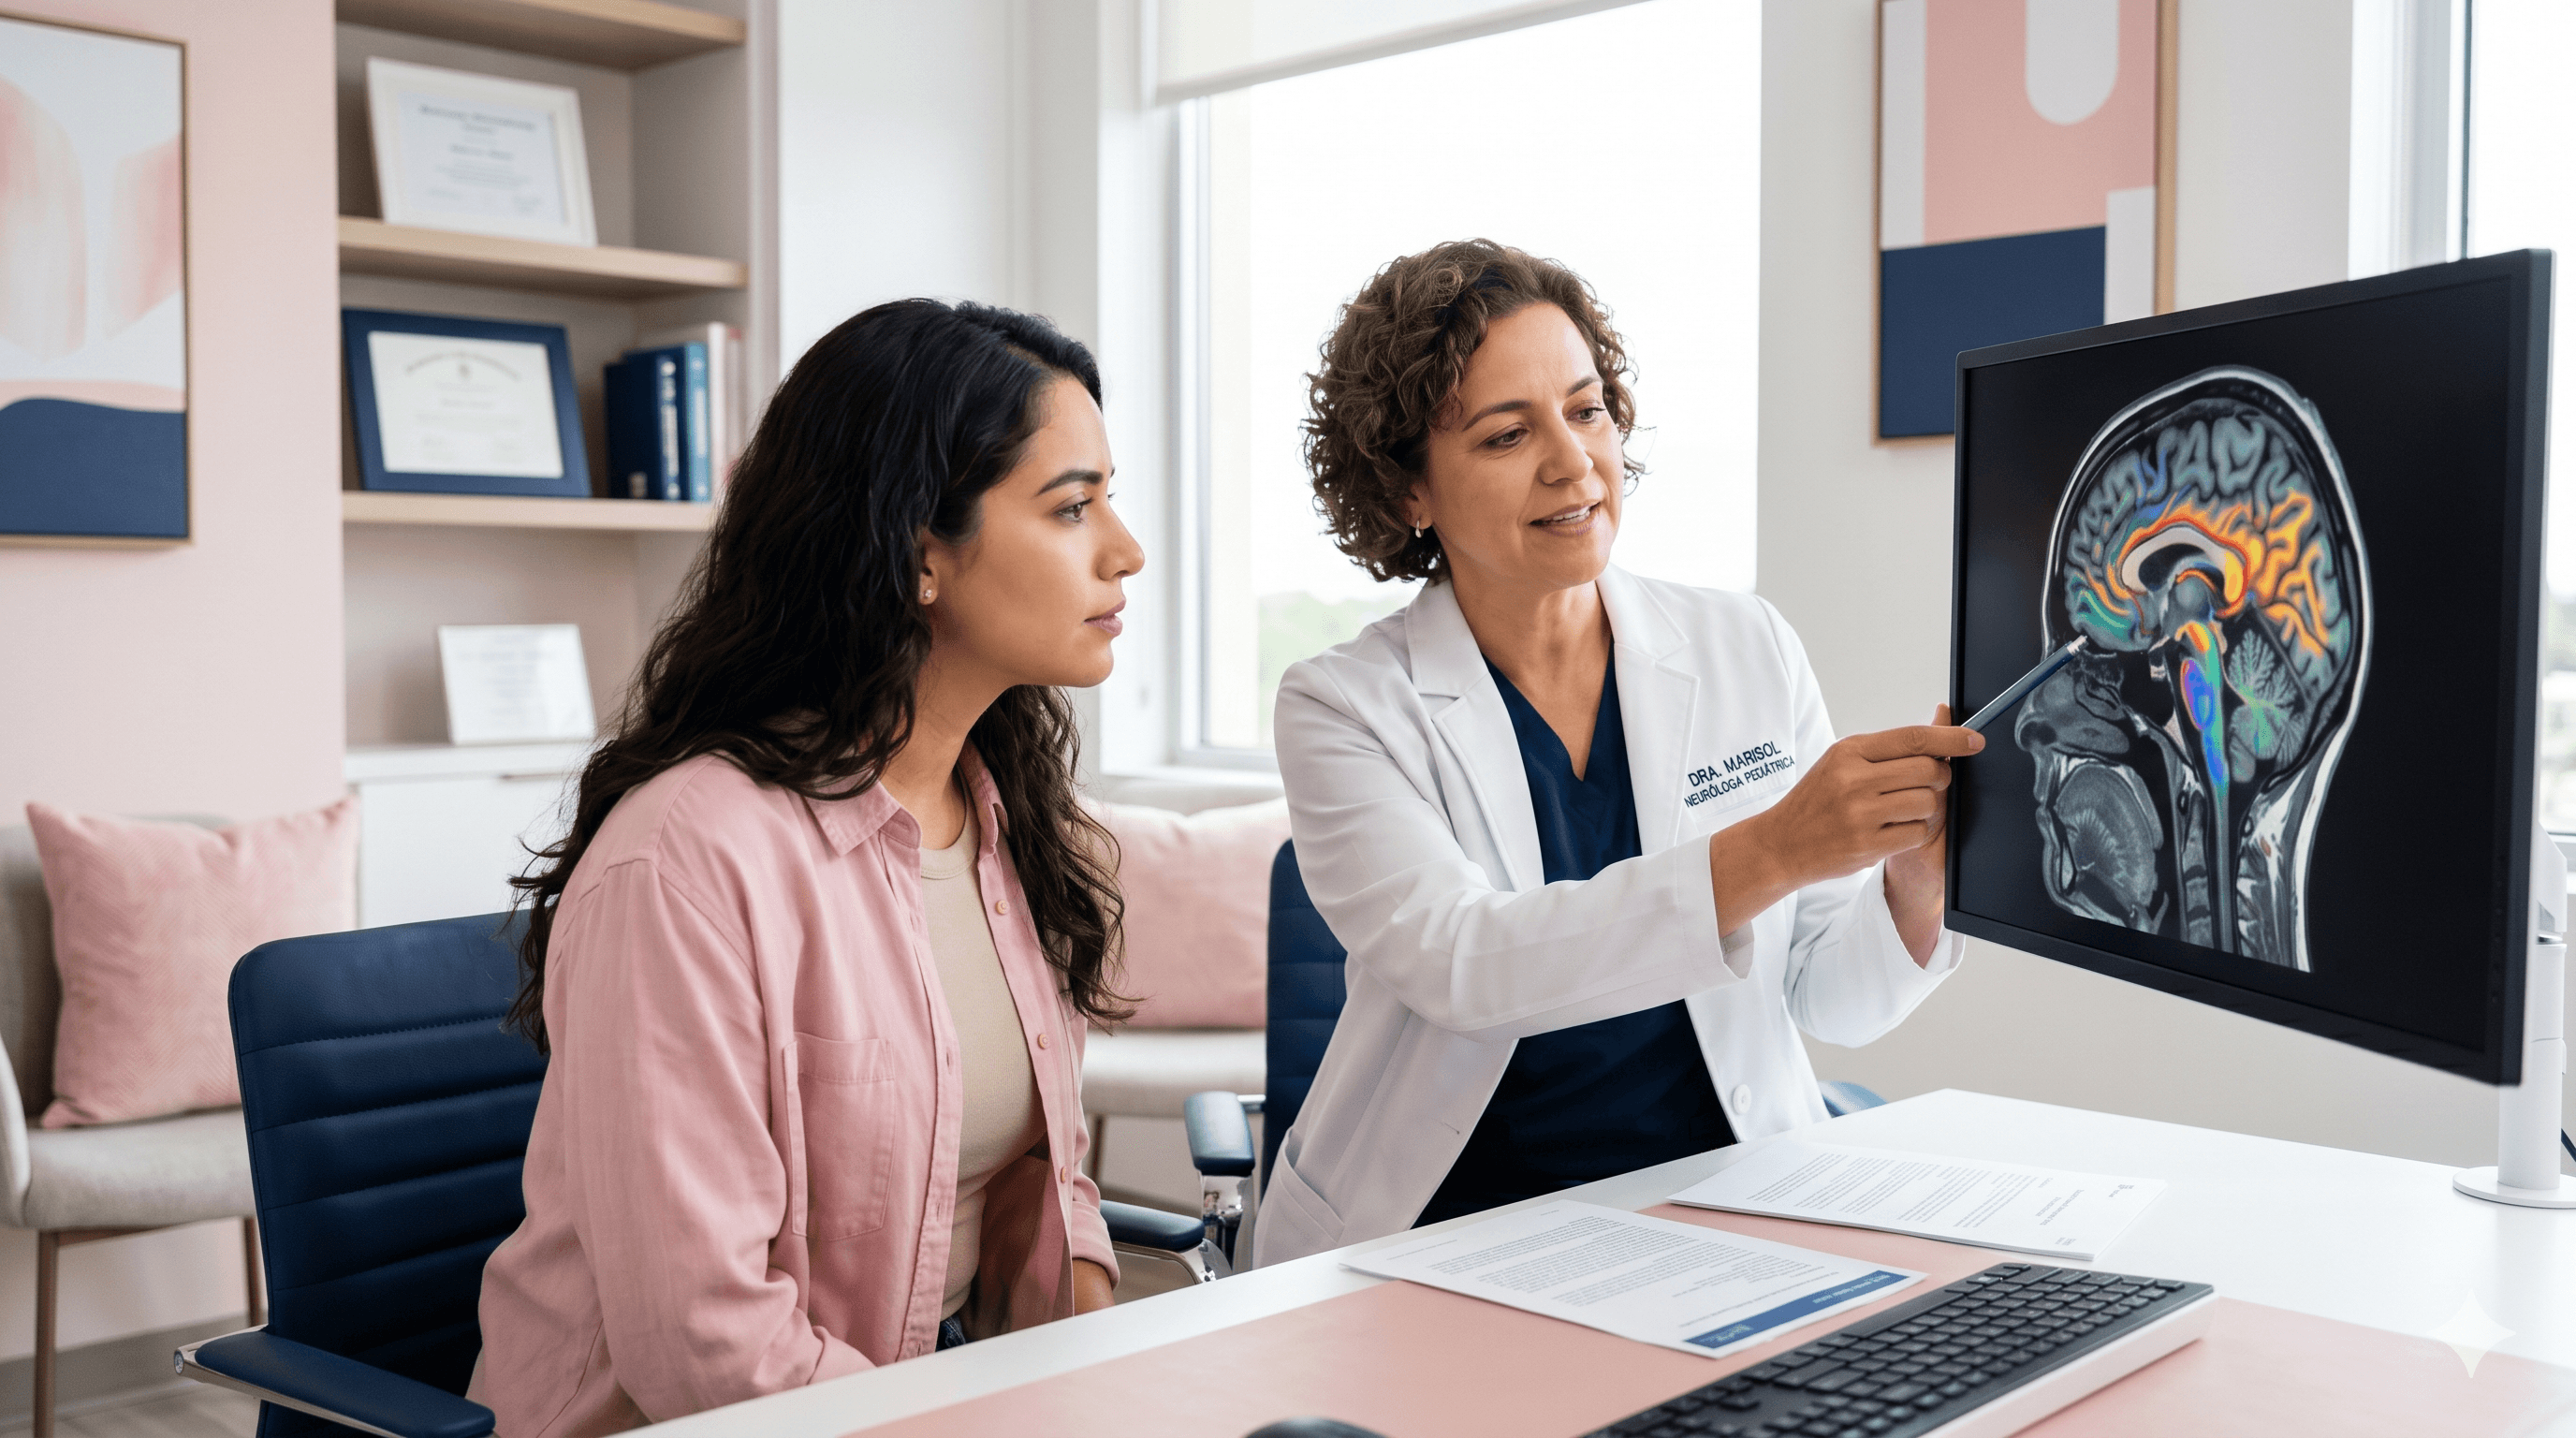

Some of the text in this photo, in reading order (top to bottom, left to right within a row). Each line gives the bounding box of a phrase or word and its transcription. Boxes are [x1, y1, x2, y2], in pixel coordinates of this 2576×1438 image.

[1688, 741, 1781, 787] DRA. MARISOL
[1684, 775, 1745, 808] NEURÓLOGA
